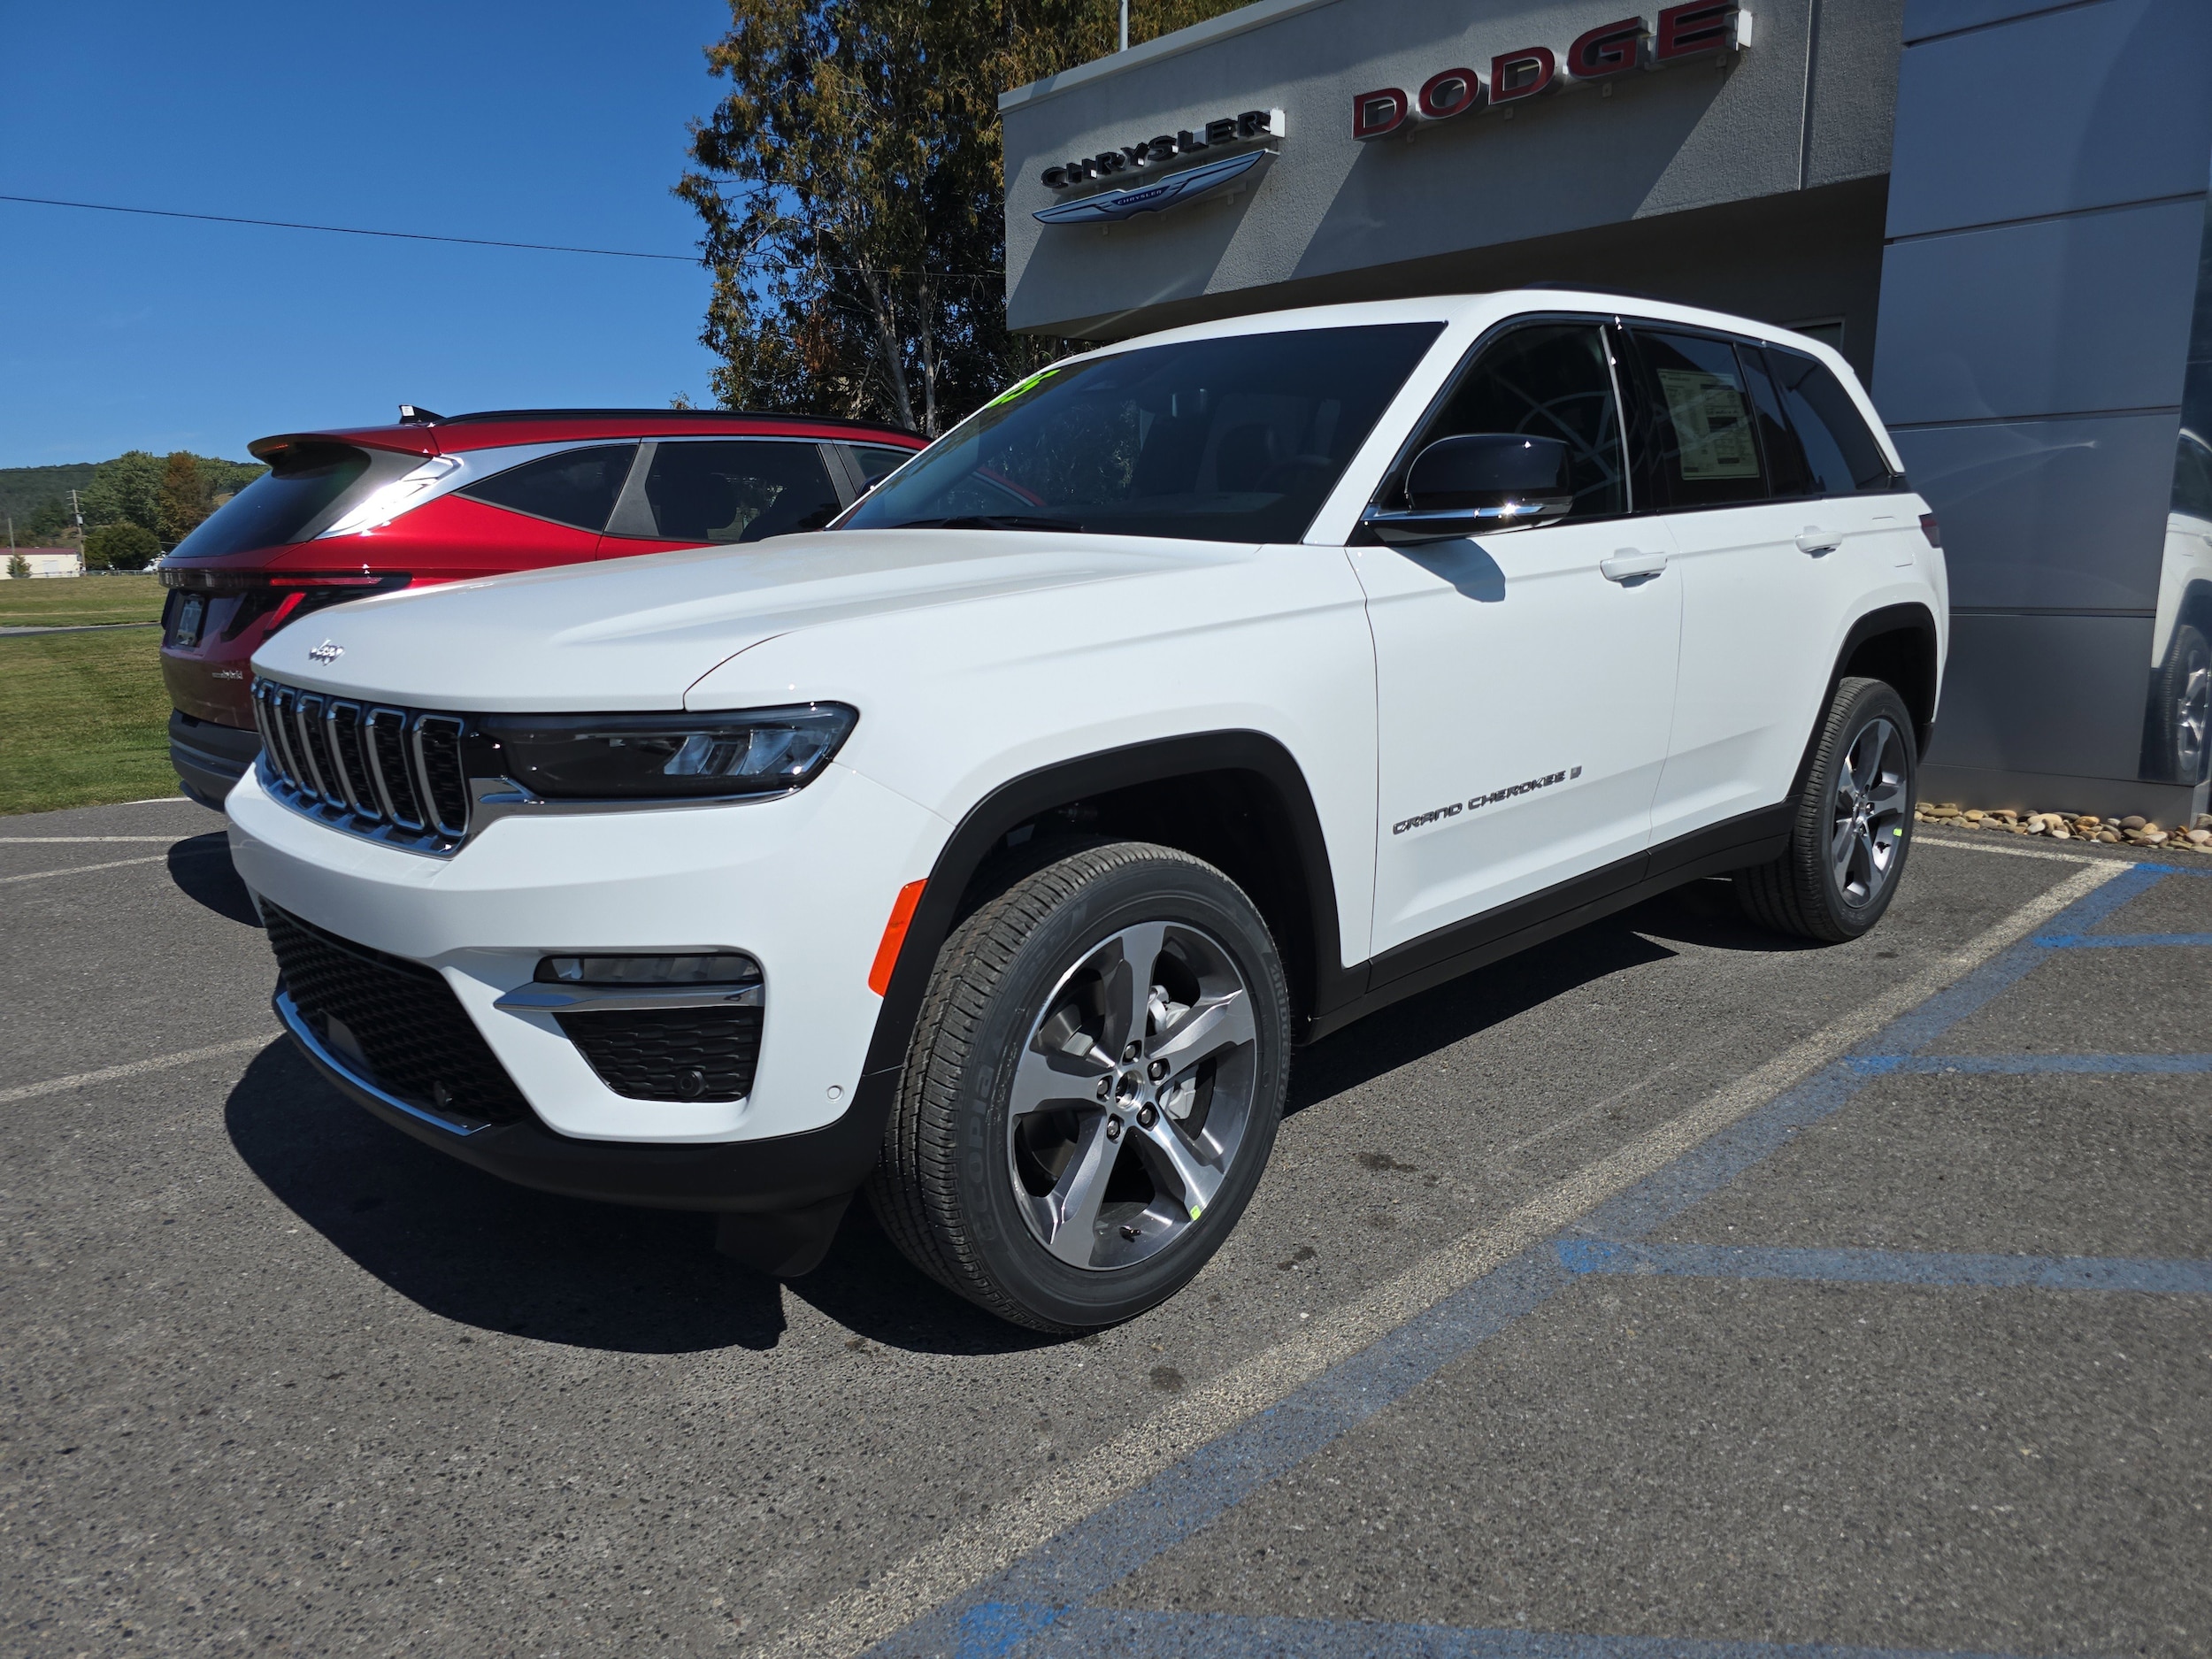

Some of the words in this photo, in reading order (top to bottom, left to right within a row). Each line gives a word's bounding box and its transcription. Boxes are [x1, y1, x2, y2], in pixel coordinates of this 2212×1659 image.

[1352, 0, 1738, 141] DODGE
[1041, 111, 1271, 188] CHRYSLER
[1117, 189, 1163, 205] CHRYSLER
[309, 639, 346, 666] Jeep
[1393, 803, 1463, 834] GRAND
[1468, 771, 1566, 810] CHEROKEE
